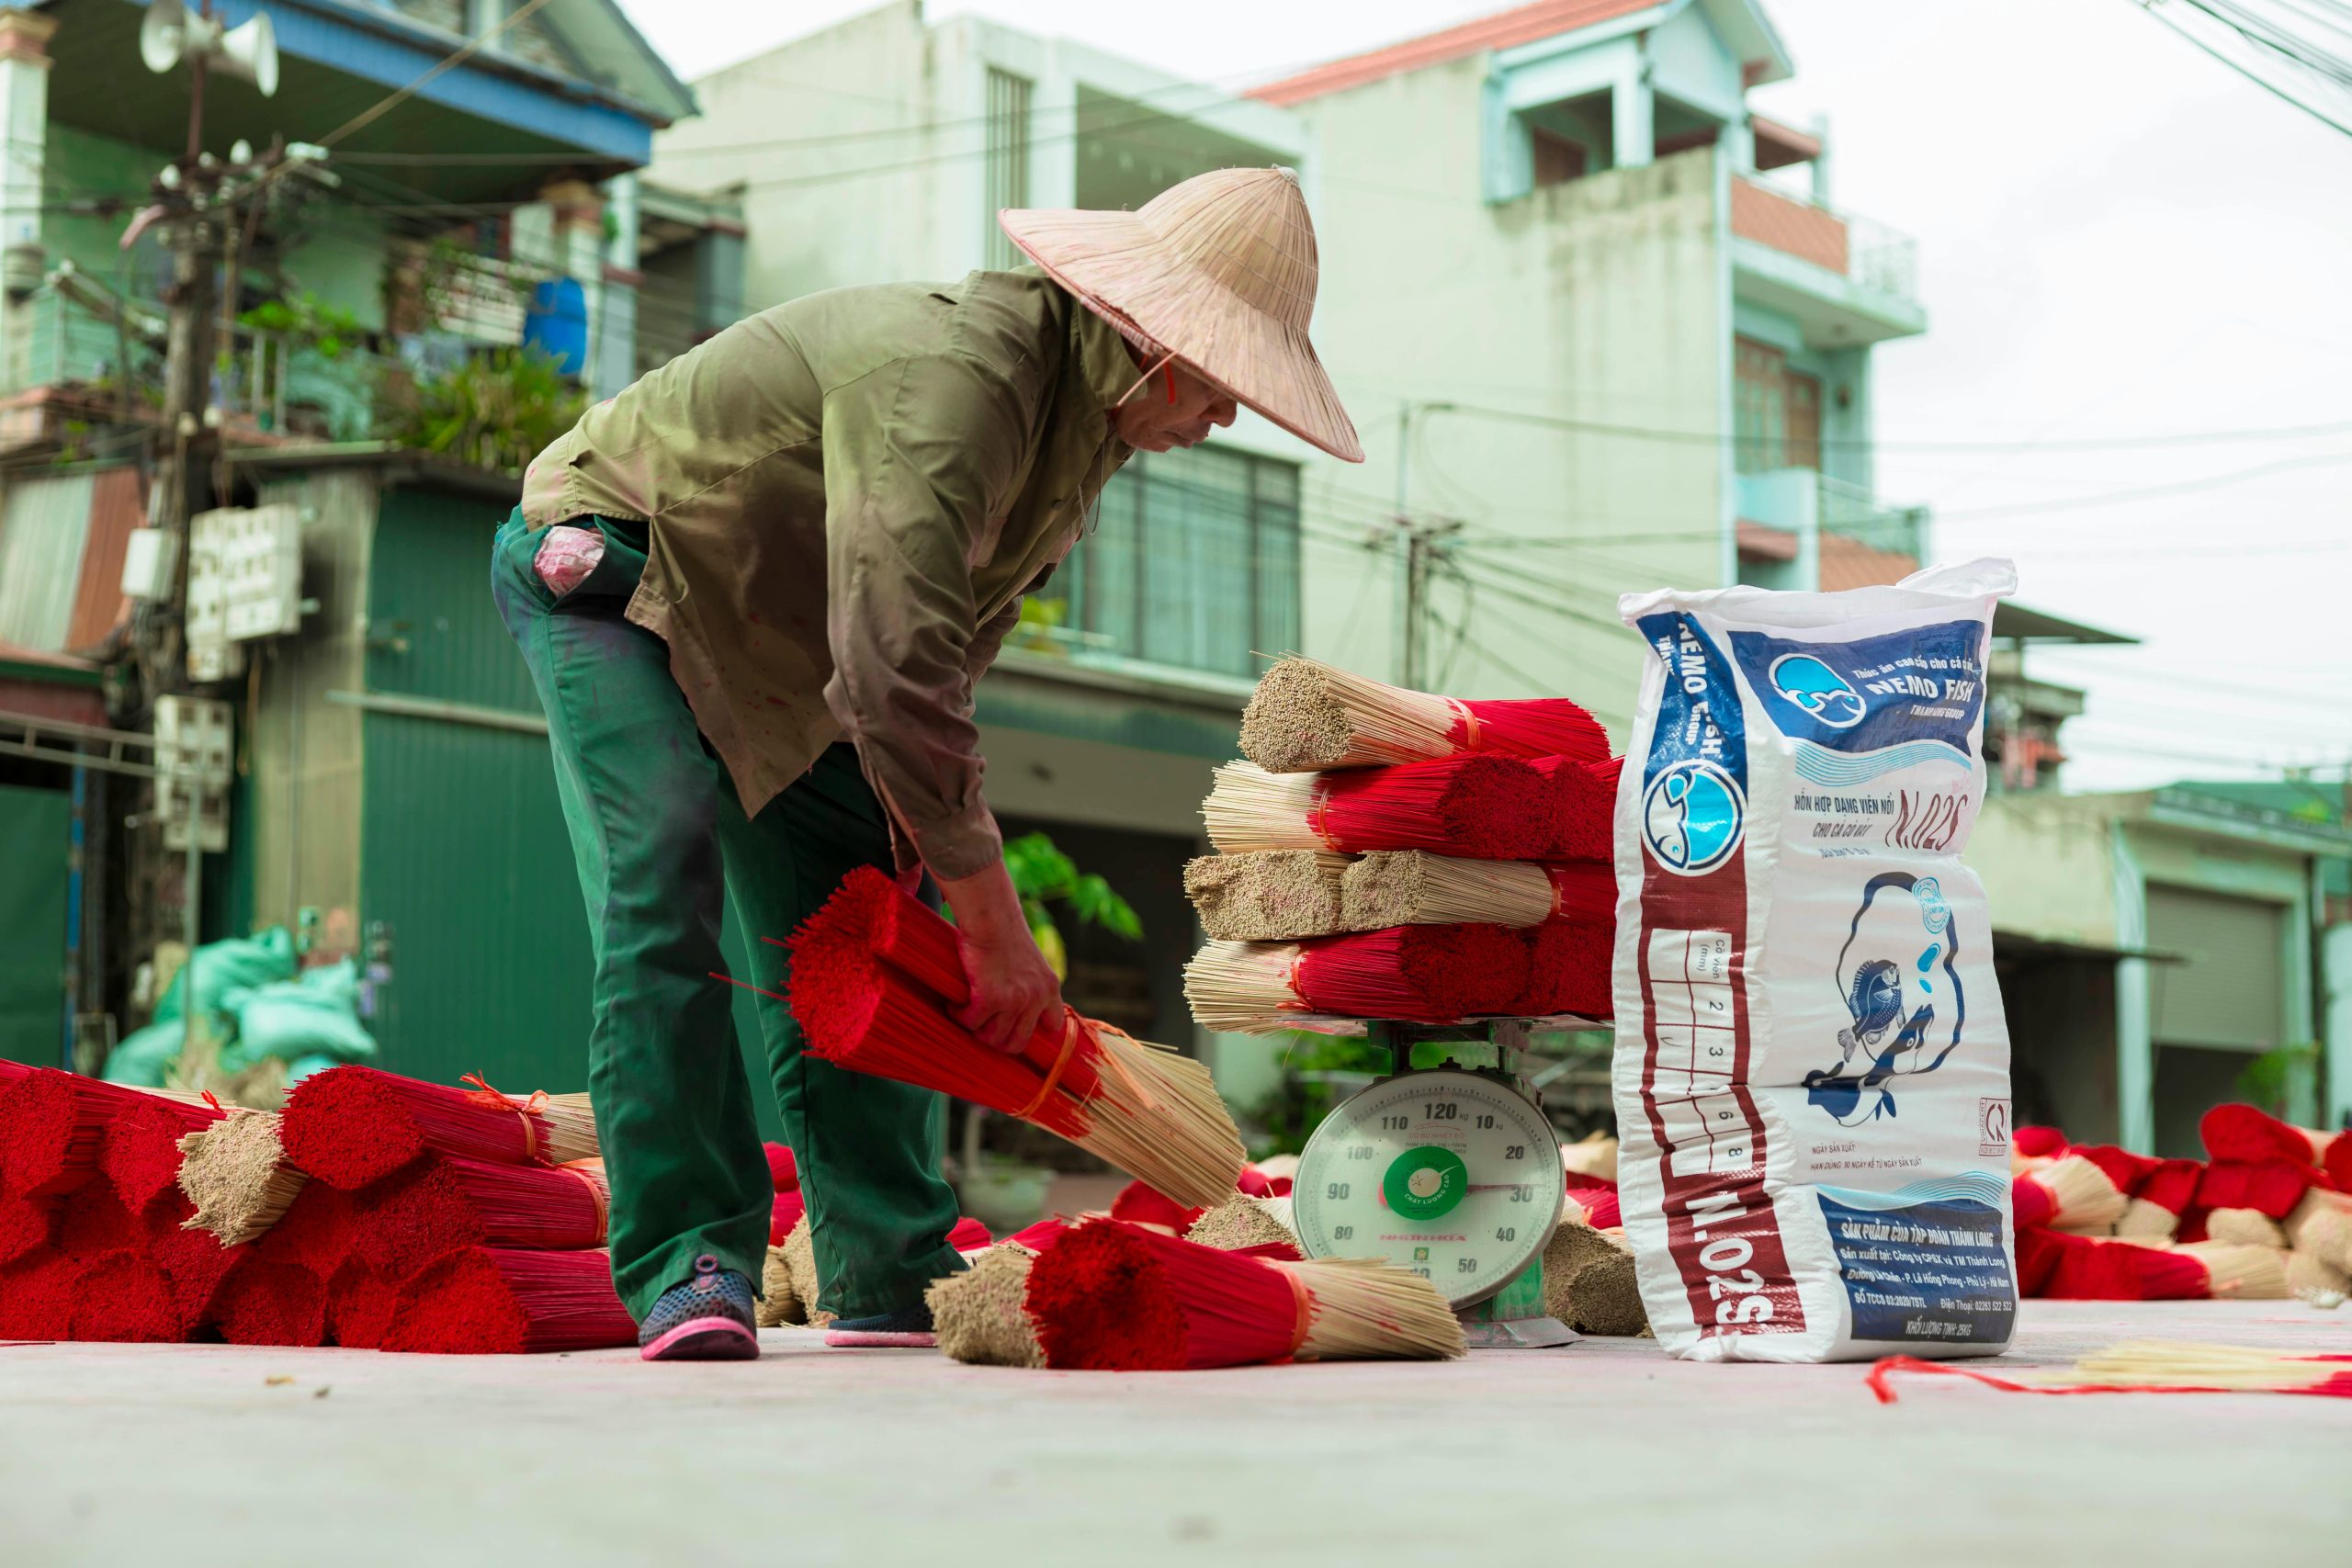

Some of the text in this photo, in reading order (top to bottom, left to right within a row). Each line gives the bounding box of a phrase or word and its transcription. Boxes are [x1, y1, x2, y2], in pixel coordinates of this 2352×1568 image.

[1678, 622, 1707, 694] NEMO
[1895, 657, 1915, 667] cao
[1929, 658, 1948, 669] cho
[1951, 656, 1962, 669] cá
[1865, 675, 1975, 702] NEMO FISH
[1815, 795, 1831, 815] HỢP
[1835, 797, 1858, 818] DẠNG
[1860, 795, 1879, 815] VIÊN
[1885, 789, 1968, 851] N.02S
[1813, 823, 1832, 838] CHO
[1699, 944, 1709, 972] (mm)
[1710, 1000, 1724, 1011] 2
[1709, 1047, 1724, 1056] 3
[1424, 1103, 1457, 1120] 120
[1719, 1111, 1734, 1121] 6
[1382, 1116, 1408, 1130] 110
[1476, 1115, 1494, 1129] 10
[1346, 1146, 1374, 1160] 100
[1505, 1145, 1524, 1159] 20
[1728, 1147, 1743, 1157] 8
[1883, 1157, 1897, 1168] NGÀY
[1327, 1183, 1350, 1200] 90
[1510, 1186, 1533, 1202] 30
[1334, 1225, 1353, 1240] 80
[1496, 1227, 1515, 1242] 40
[1840, 1216, 1861, 1240] SẢN
[1891, 1220, 1909, 1243] CỦA
[1949, 1226, 1975, 1247] THÀNH
[1975, 1231, 1994, 1247] LONG
[1839, 1246, 1857, 1259] Sản
[1859, 1246, 1878, 1260] xuất
[1893, 1250, 1915, 1264] Công
[1913, 1253, 1923, 1264] ty
[1942, 1255, 1953, 1266] và
[1953, 1256, 1966, 1266] TM
[1966, 1255, 1988, 1266] Thành
[1988, 1257, 2006, 1269] Long
[1457, 1258, 1477, 1273] 50
[1905, 1273, 1914, 1283] P.
[1941, 1274, 1964, 1289] Phong
[1997, 1277, 2010, 1288] Nam
[1854, 1289, 1866, 1304] SỐ
[1866, 1293, 1885, 1305] TCCS
[1940, 1298, 1956, 1313] Điện
[1956, 1300, 1974, 1315] Thoại:
[1992, 1302, 2002, 1312] 522
[2002, 1302, 2013, 1312] 522
